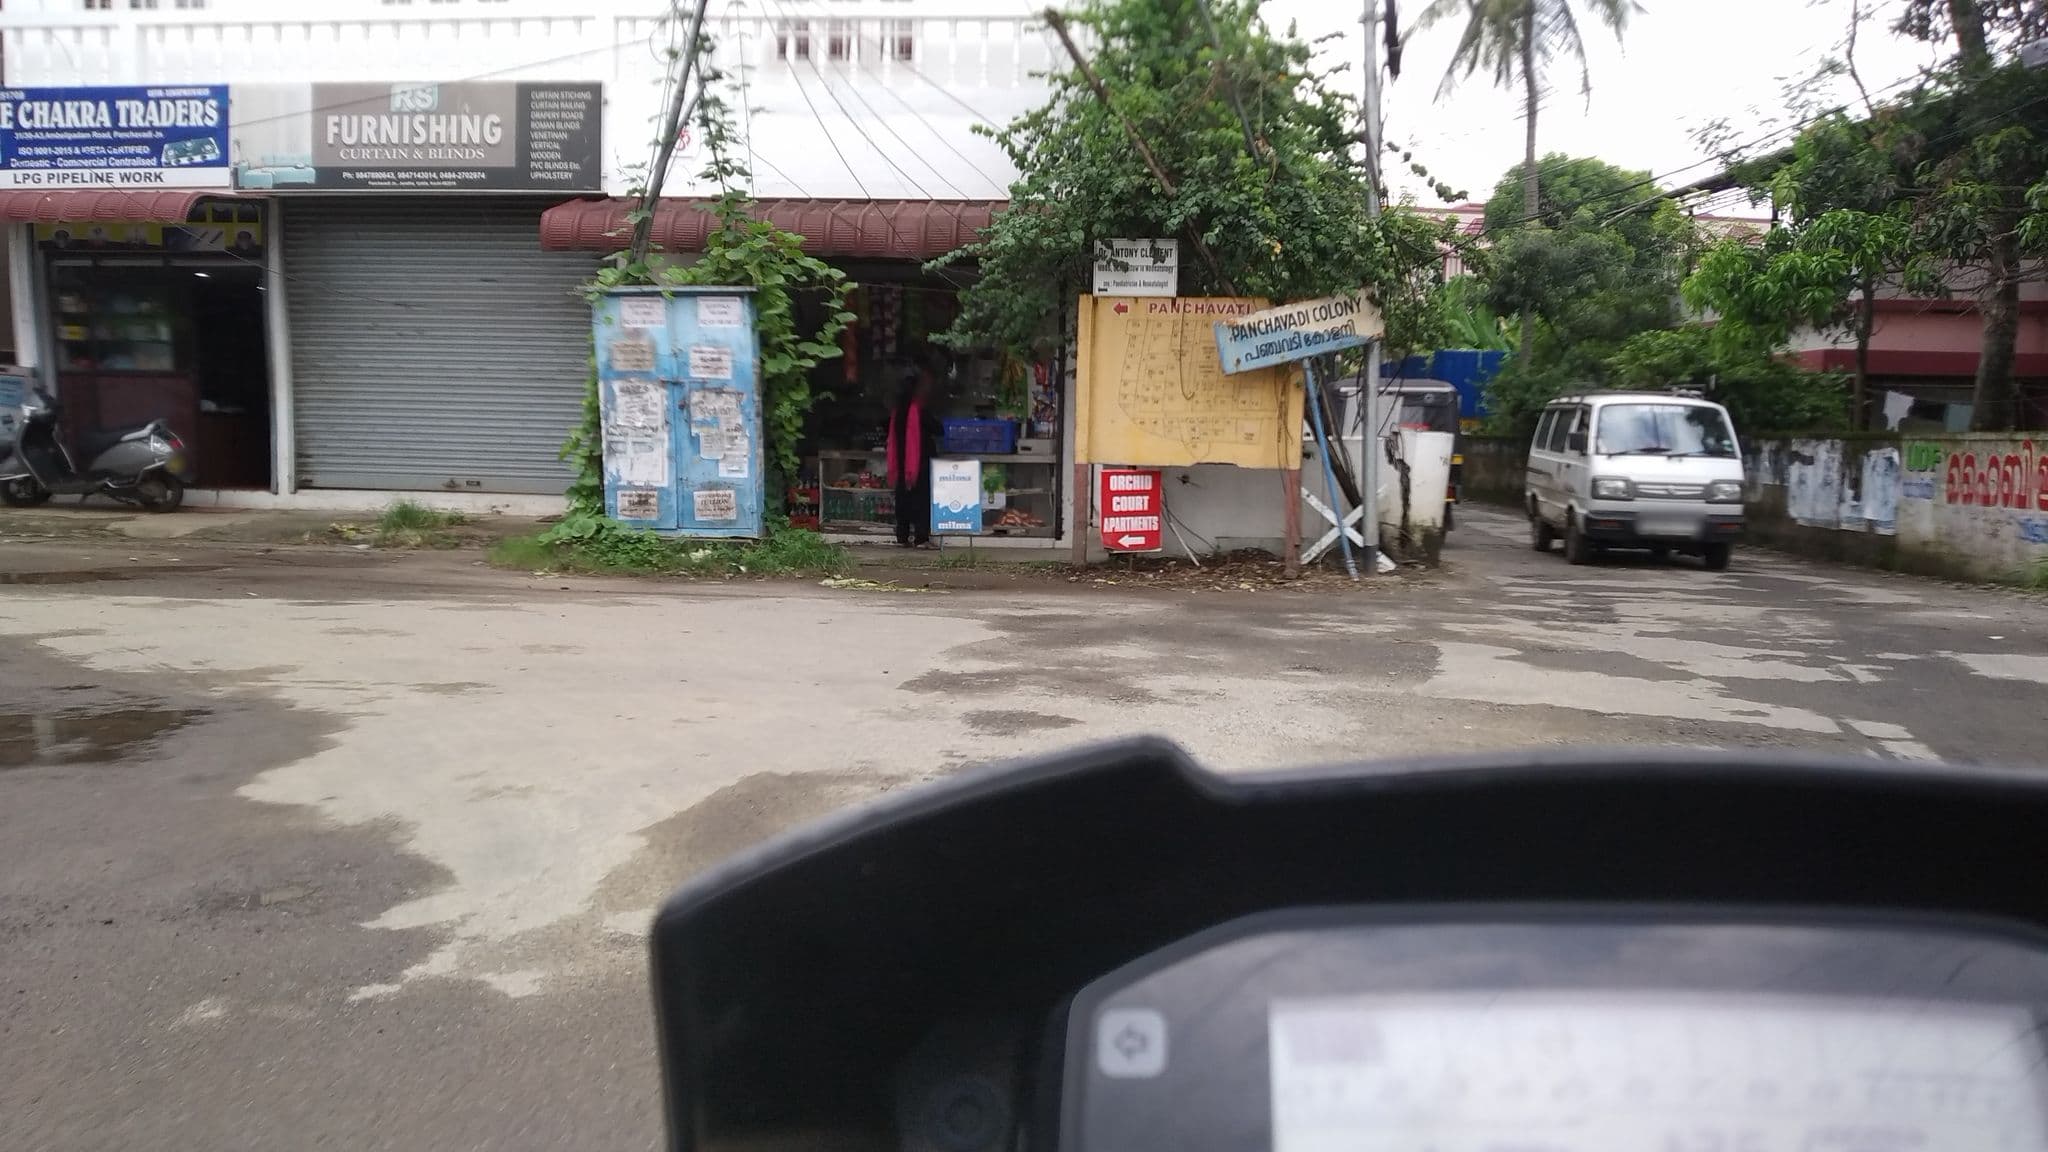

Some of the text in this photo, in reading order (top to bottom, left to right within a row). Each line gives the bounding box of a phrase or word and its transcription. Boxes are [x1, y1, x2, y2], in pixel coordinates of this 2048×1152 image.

[530, 91, 559, 100] CURTAIN
[530, 101, 559, 110] CURTAIN
[18, 100, 112, 129] CHAKRA
[115, 98, 219, 128] TRADERS
[326, 114, 502, 145] FURNISHING
[530, 121, 555, 130] ROMAN
[18, 147, 33, 155] ISO
[530, 141, 560, 150] VERTICAL
[340, 148, 486, 160] CURTAIN & BLINDS
[530, 151, 561, 160] WOODEN
[10, 158, 50, 168] Domestic
[57, 157, 108, 167] Commercial
[108, 156, 157, 166] Centralised
[530, 161, 543, 170] PVC
[544, 161, 568, 170] BLINDS
[13, 171, 164, 184] LPG PIPELINE WORK
[530, 171, 573, 180] UPHOLSTERY
[1149, 303, 1251, 315] PANCHAVATI
[1230, 298, 1361, 342] PANCHAVADI COLONY
[1109, 475, 1153, 491] ORCHID
[1112, 495, 1149, 512] COURT
[938, 521, 972, 529] milma
[1103, 516, 1159, 533] APARTMENTS
